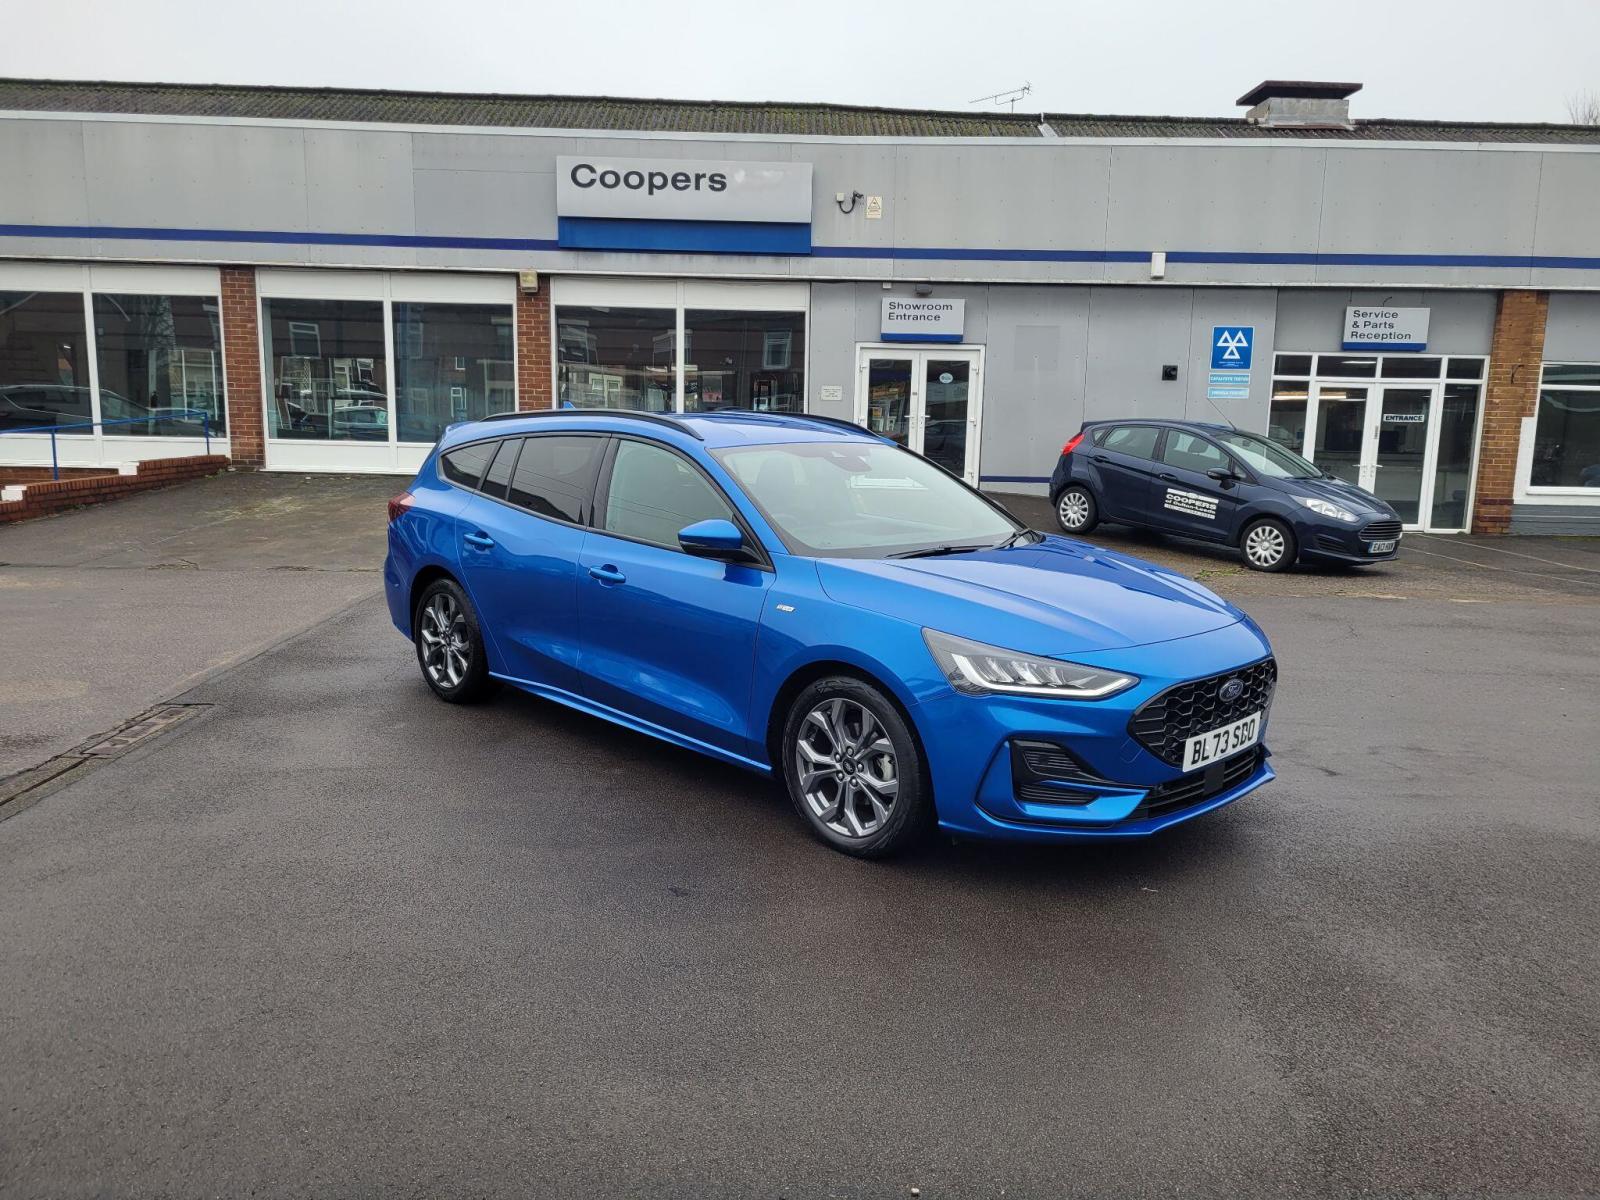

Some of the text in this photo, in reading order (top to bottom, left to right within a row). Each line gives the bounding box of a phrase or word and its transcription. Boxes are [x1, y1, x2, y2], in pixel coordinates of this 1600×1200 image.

[571, 163, 727, 195] Coopers
[888, 301, 953, 311] Showroom
[888, 312, 941, 321] Entrance
[1353, 309, 1398, 319] Service
[1352, 320, 1395, 329] & Parts
[1350, 331, 1412, 341] Reception
[1166, 493, 1216, 510] COOPERS
[1191, 730, 1230, 765] BL73
